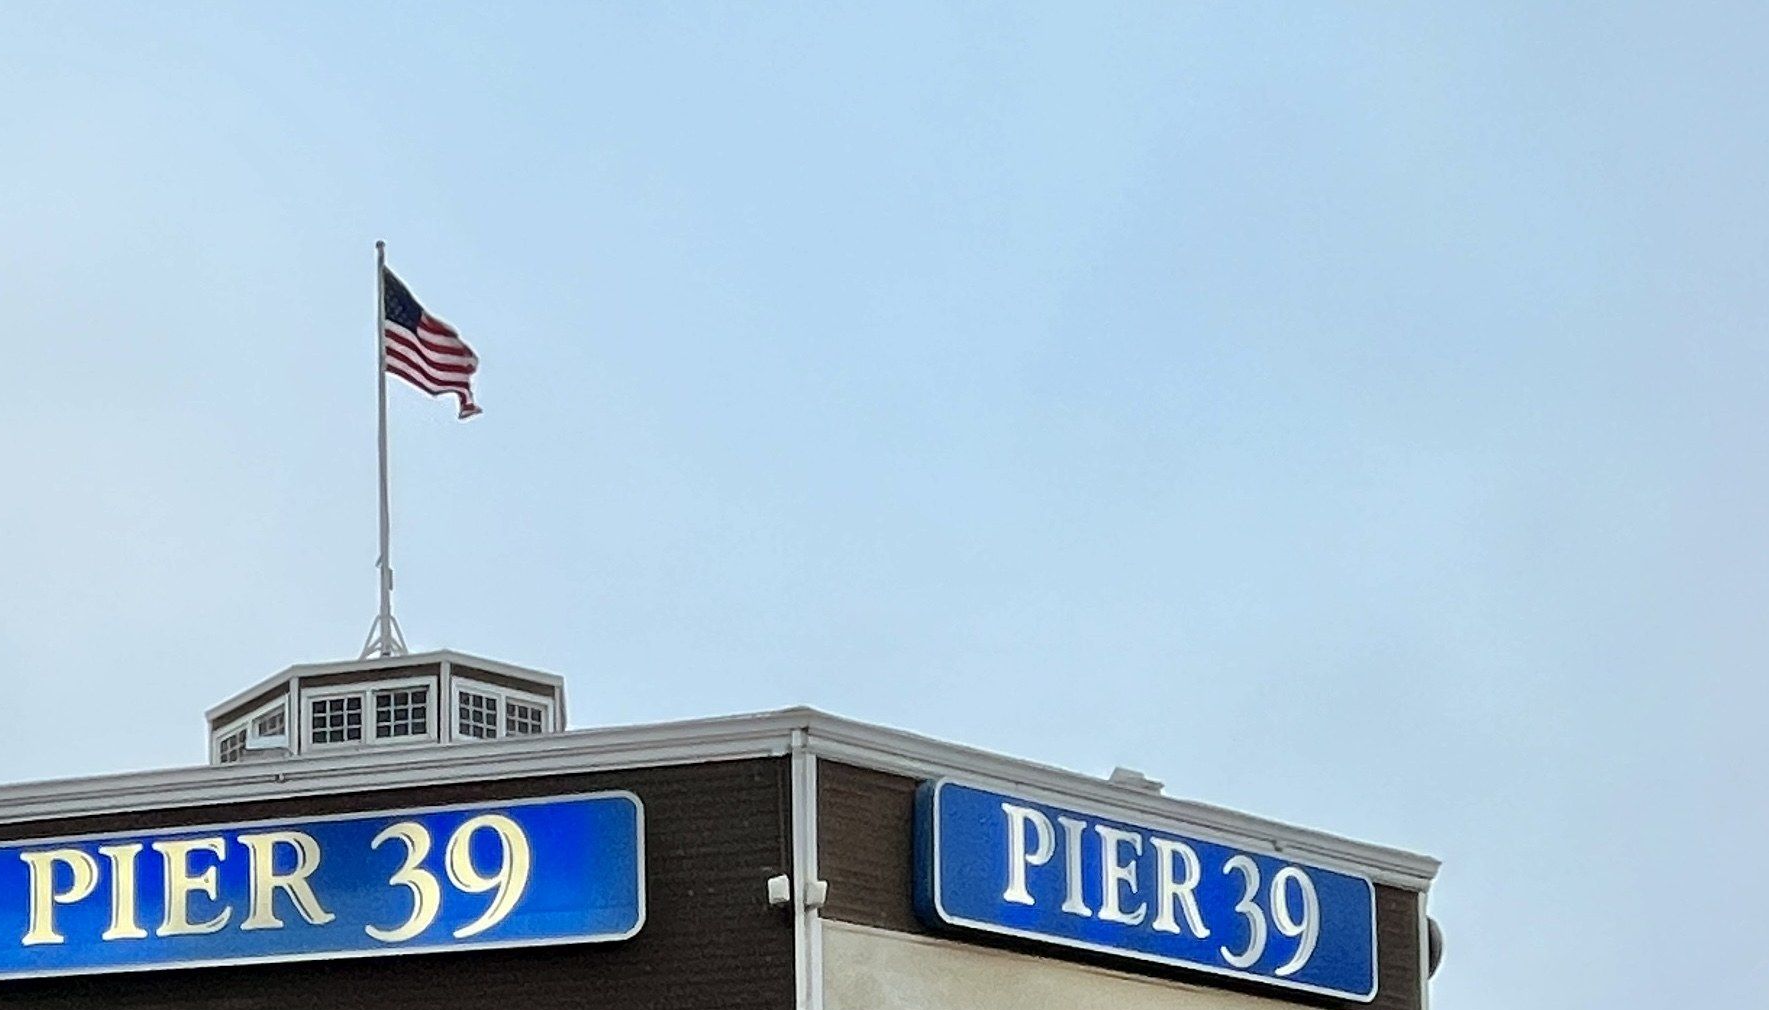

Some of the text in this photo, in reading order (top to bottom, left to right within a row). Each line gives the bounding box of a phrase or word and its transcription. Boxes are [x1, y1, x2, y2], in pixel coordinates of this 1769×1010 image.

[20, 814, 530, 946] PIER 39
[1001, 802, 1321, 977] PIER 39
